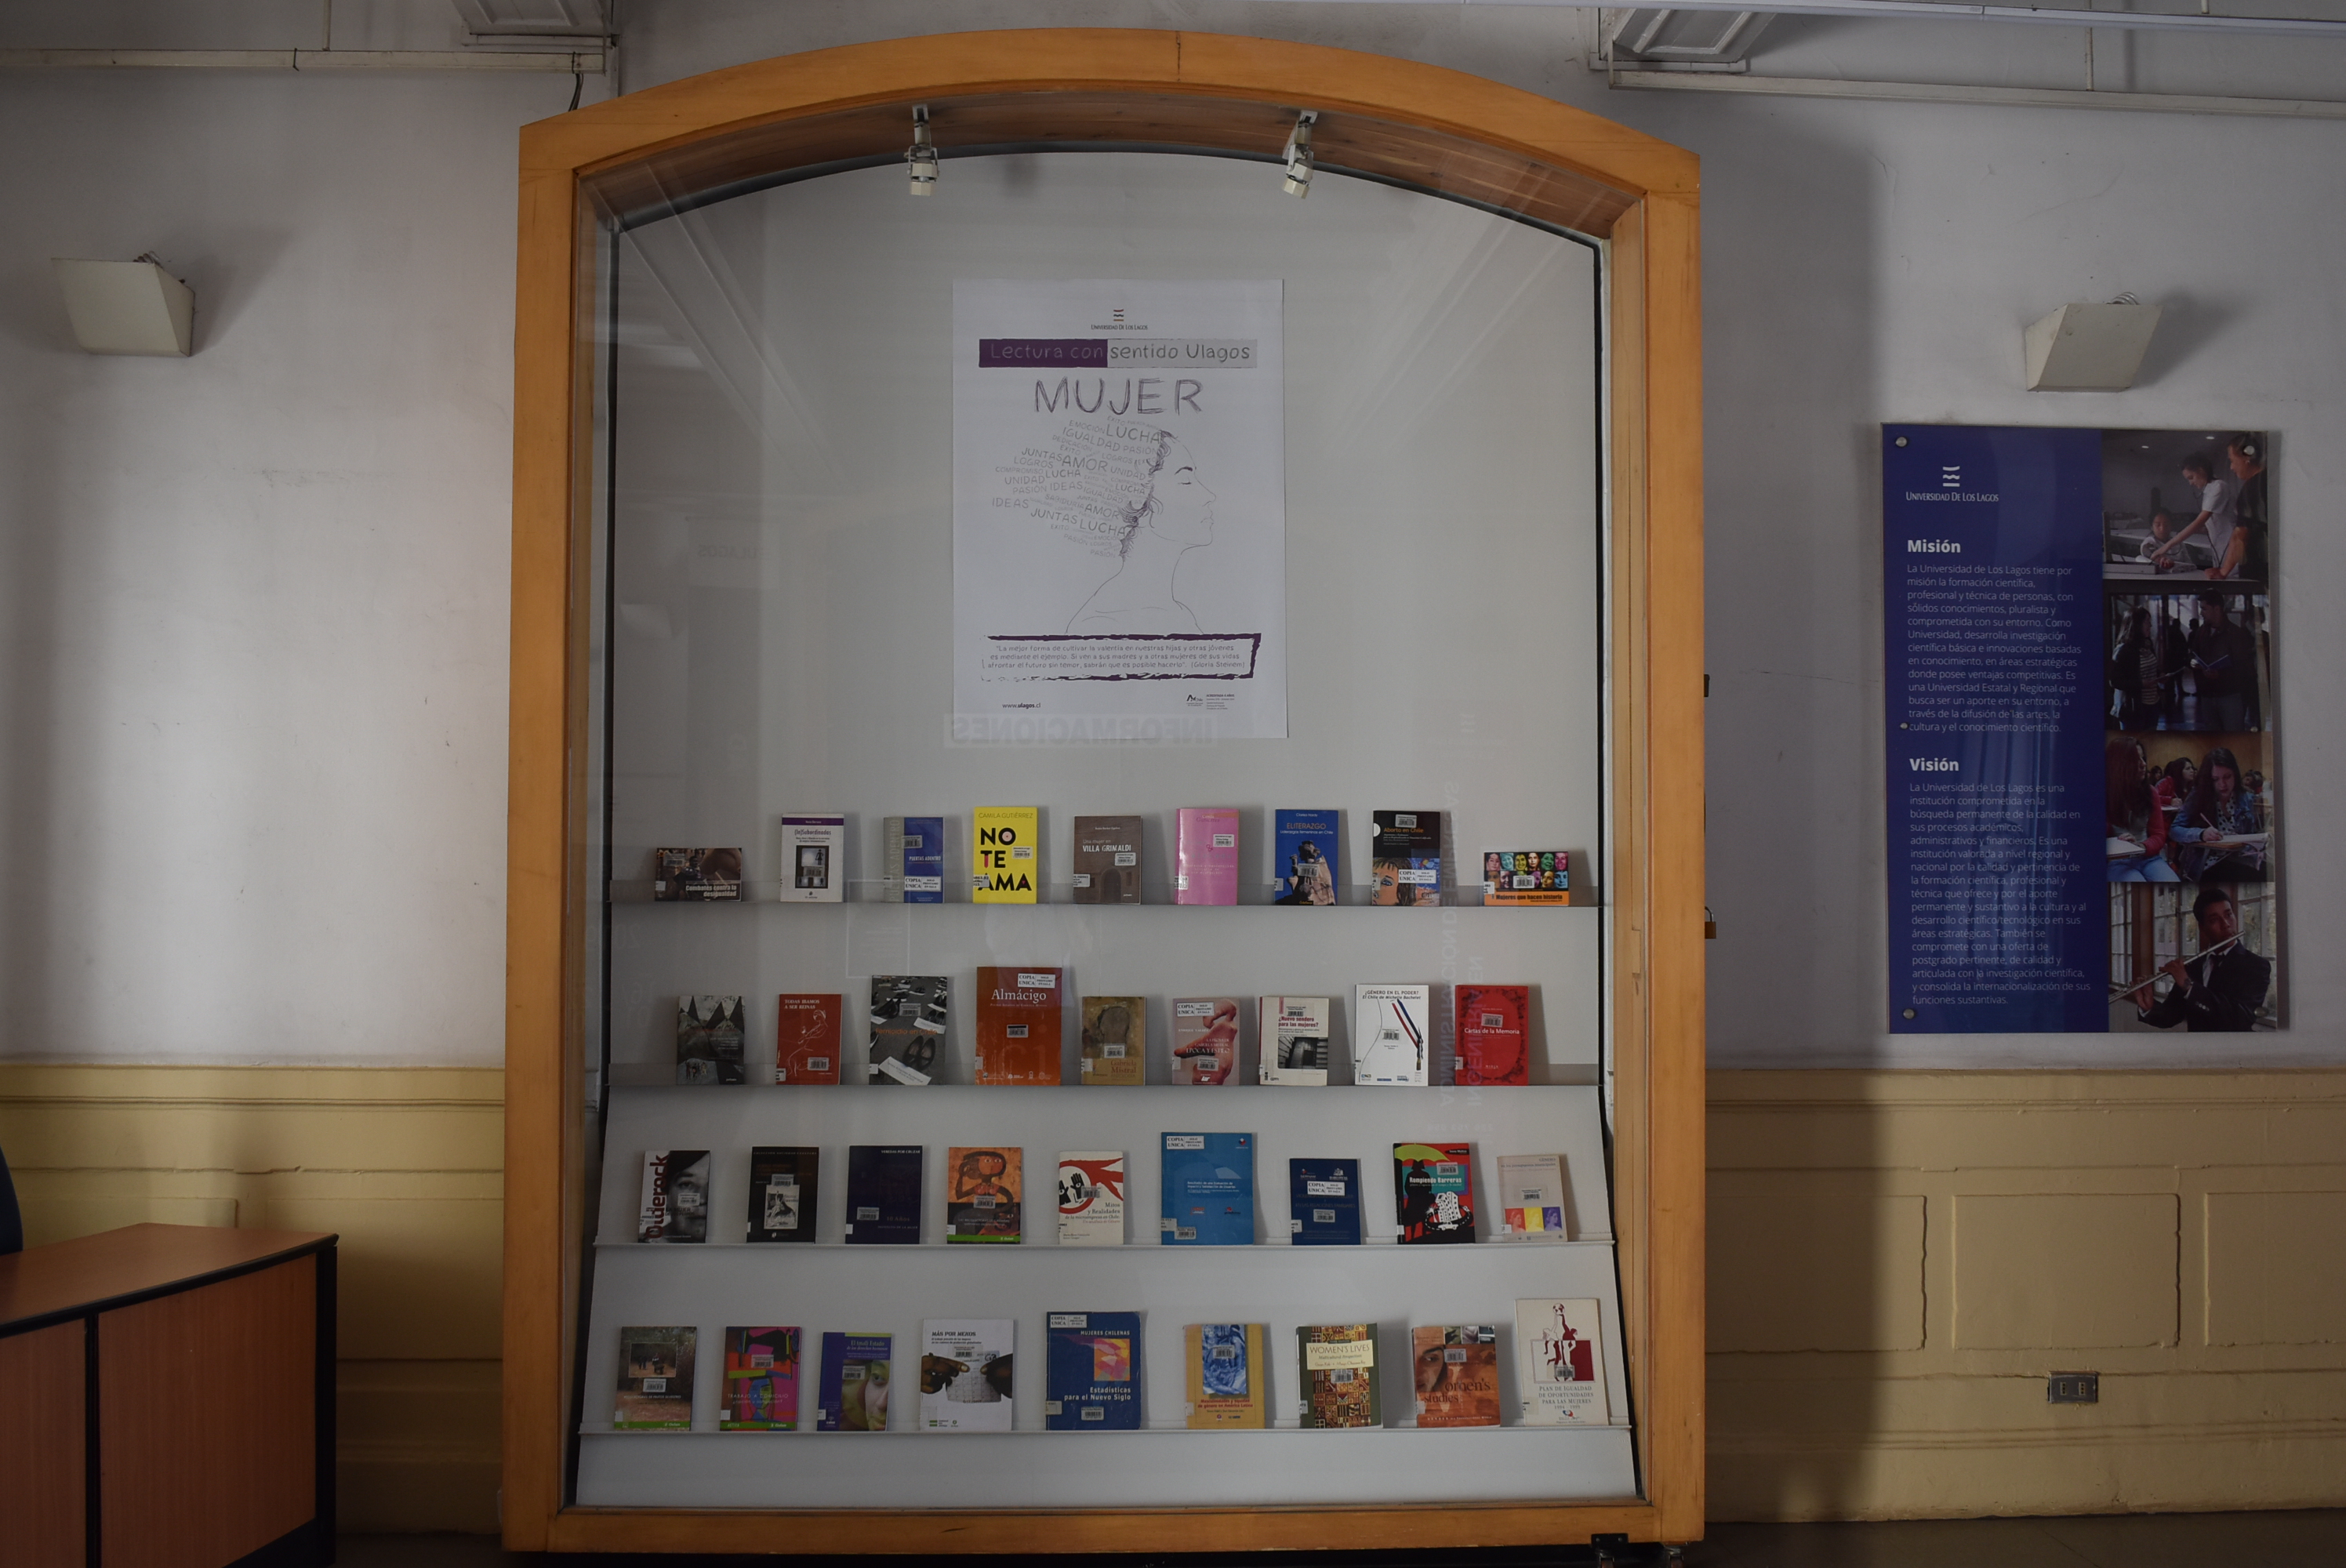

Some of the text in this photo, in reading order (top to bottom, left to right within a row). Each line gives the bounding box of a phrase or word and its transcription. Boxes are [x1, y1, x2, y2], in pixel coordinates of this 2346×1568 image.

[991, 343, 1249, 362] Lectura con sentido Ulagos
[1035, 376, 1202, 416] MUJER
[1063, 427, 1120, 452] IGUALDAD
[1106, 424, 1160, 444] LUCHA
[1022, 448, 1062, 461] JUNTAS
[1014, 456, 1053, 469] LOGROS
[1062, 455, 1108, 472] AMOR
[1046, 469, 1080, 478] LUCHA
[1004, 476, 1044, 485] UNIDAD
[1051, 481, 1083, 491] IDEAS
[1115, 484, 1145, 495] LUCHA
[993, 498, 1029, 509] IDEAS
[1905, 492, 1999, 502] UNIVERSIDAD DE LOS LAGOS
[1030, 508, 1077, 524] JUNTAS
[1084, 503, 1120, 520] AMOR
[1080, 518, 1125, 536] LUCHA
[1908, 539, 1960, 553] Misión
[1919, 564, 1971, 573] Universidad
[1974, 564, 1985, 573] de
[1988, 565, 2003, 574] Los
[2005, 566, 2031, 576] Lagos
[2057, 568, 2072, 576] por
[1907, 577, 2035, 587] misión la formación científica,
[1908, 590, 1956, 601] profesional
[1958, 593, 1963, 601] y
[1966, 590, 1996, 600] técnica
[1999, 591, 2010, 600] de
[2013, 593, 2055, 602] personas,
[1907, 602, 2056, 615] sólidos conocimientos, pluralista y
[1908, 757, 1959, 771] Visión
[1927, 824, 1967, 833] procesos
[980, 827, 1015, 845] NO
[980, 850, 1005, 868] TE
[992, 988, 1047, 1003] Almácigo
[1912, 995, 1956, 1004] funciones
[1309, 1344, 1369, 1354] WOMEN'S LIVES
[1424, 1392, 1458, 1403] studies
